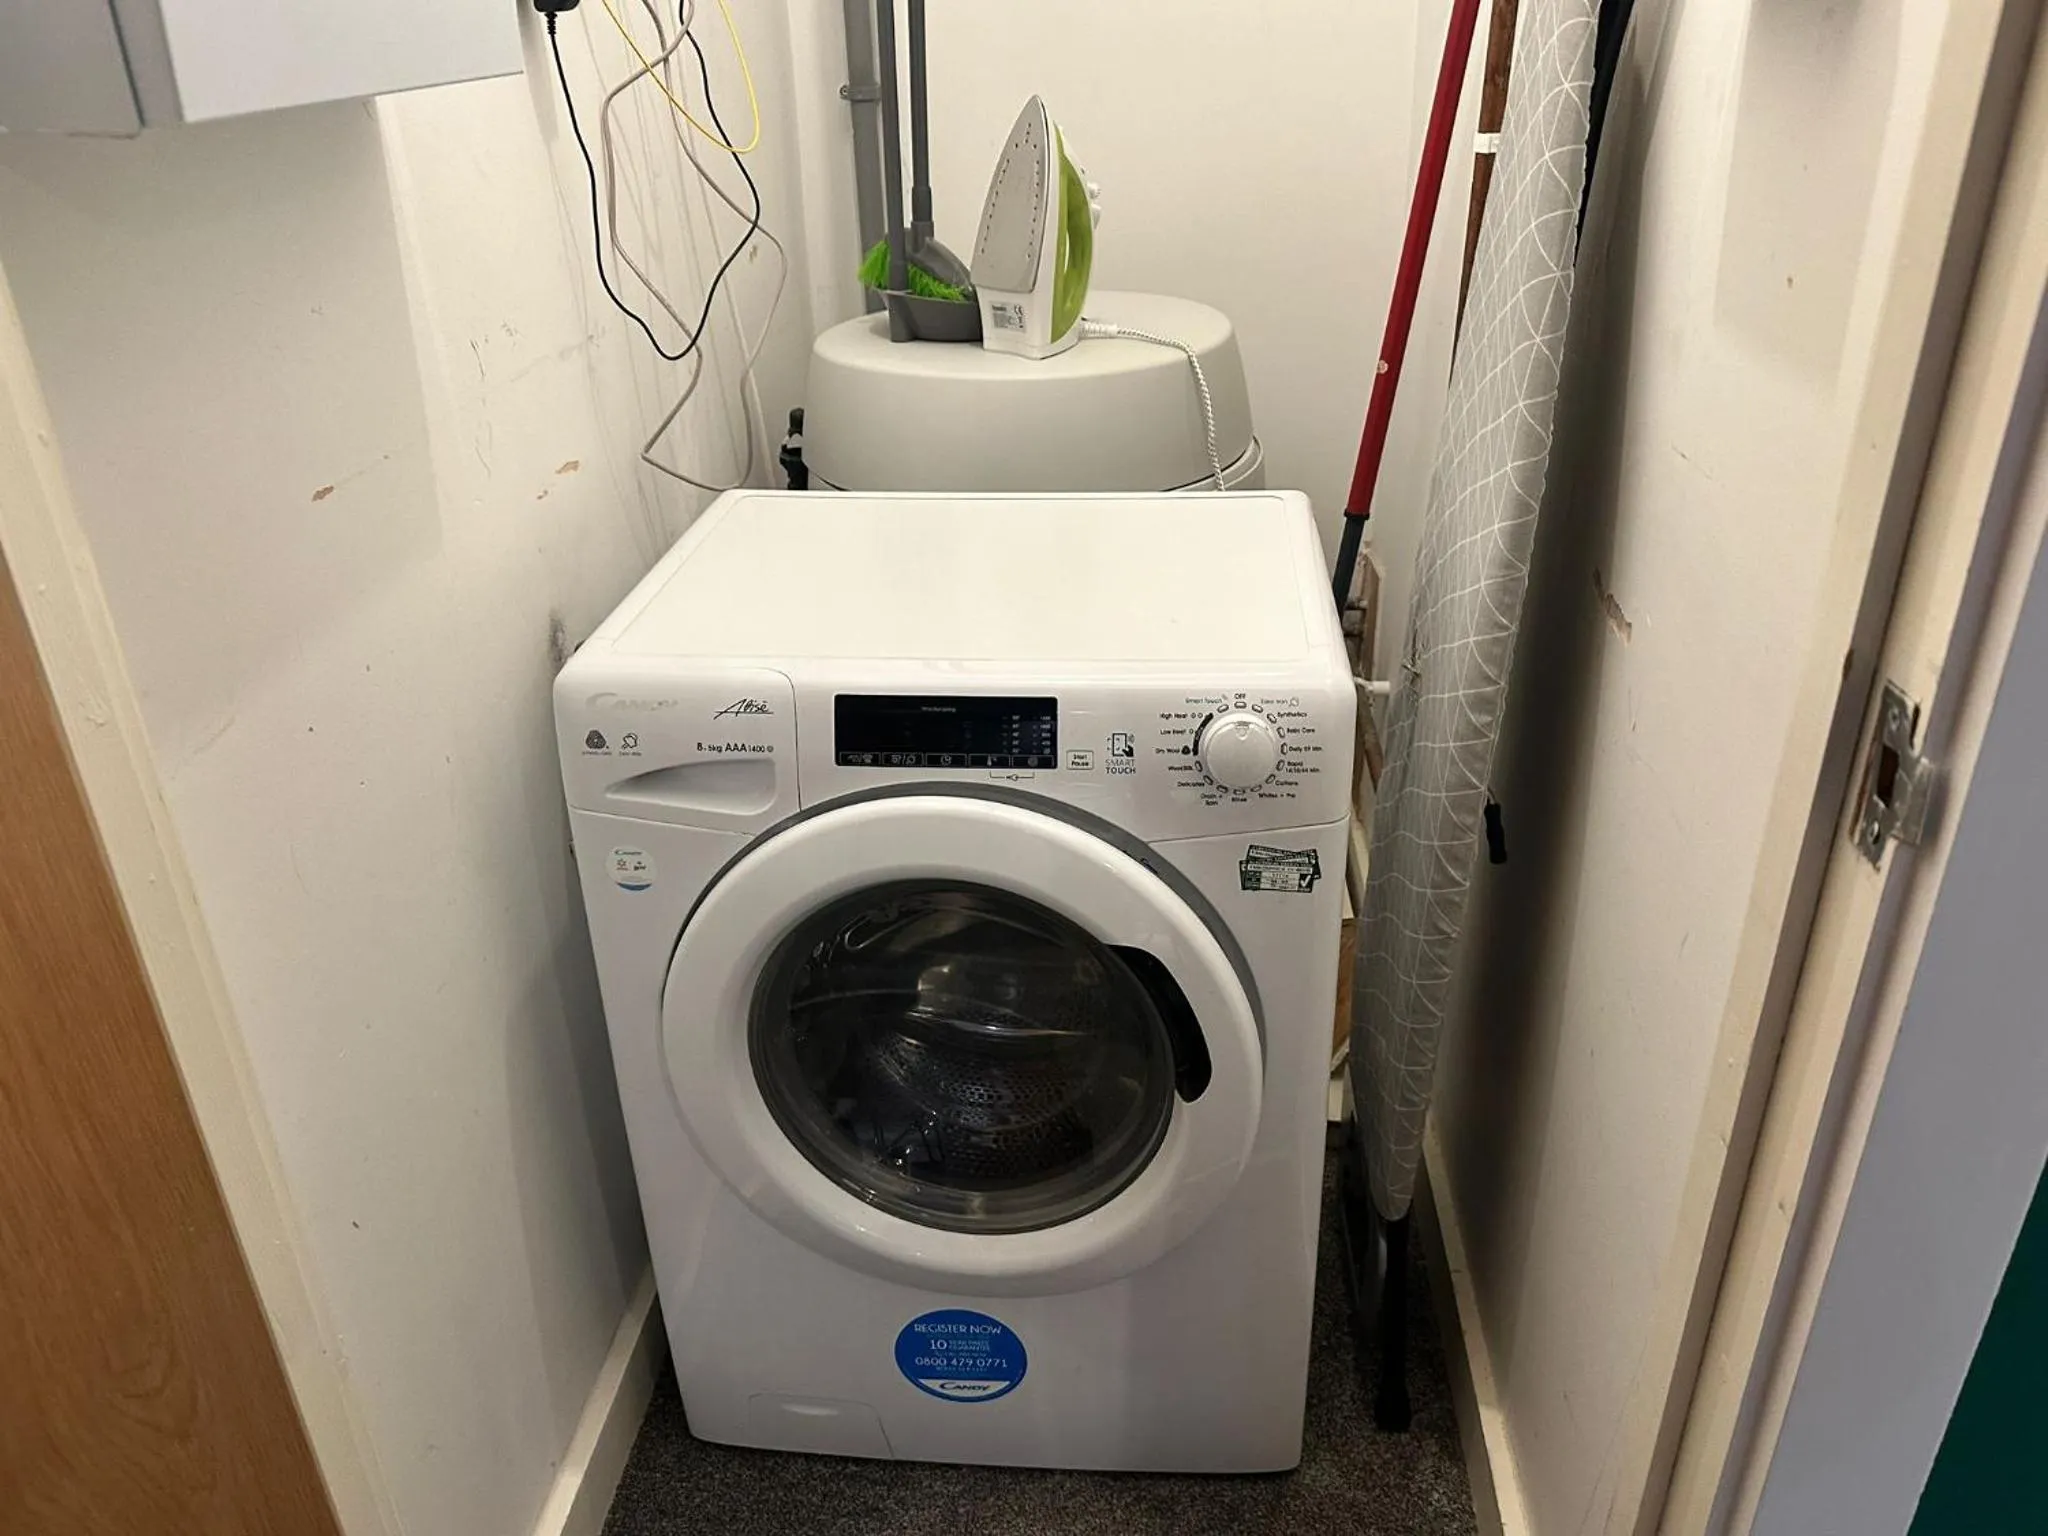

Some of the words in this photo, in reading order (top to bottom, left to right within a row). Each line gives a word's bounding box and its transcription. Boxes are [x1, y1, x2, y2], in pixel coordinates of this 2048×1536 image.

[1105, 758, 1136, 767] SMART
[1106, 766, 1136, 775] TOUCH
[914, 1323, 967, 1334] REGISTER
[969, 1324, 1002, 1335] NOW
[929, 1338, 948, 1350] 10
[915, 1356, 947, 1367] 0800
[950, 1357, 973, 1367] 479
[976, 1358, 1008, 1369] 0771
[939, 1381, 991, 1392] CANDY
